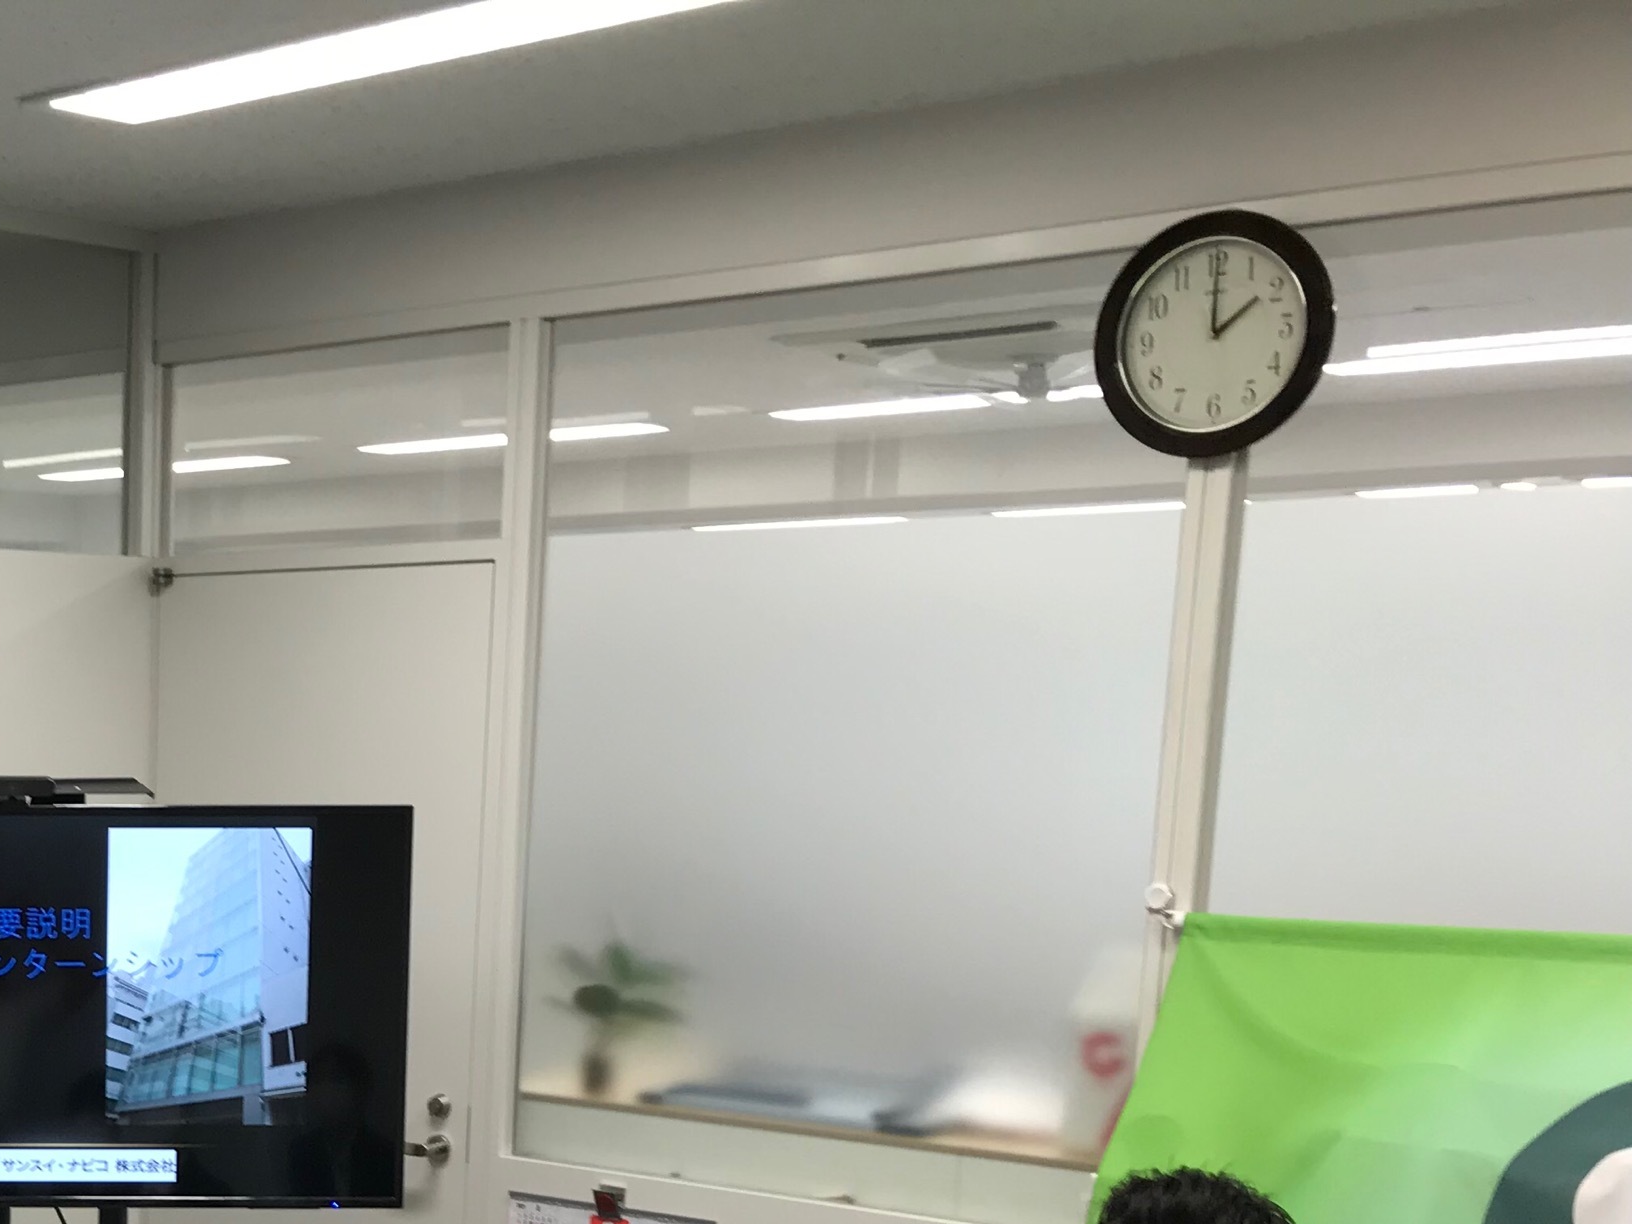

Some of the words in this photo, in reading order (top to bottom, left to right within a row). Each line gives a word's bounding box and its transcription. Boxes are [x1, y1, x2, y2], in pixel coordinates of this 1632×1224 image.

[1174, 266, 1189, 291] 11
[1248, 256, 1255, 281] 1
[1269, 277, 1284, 303] 2
[1148, 294, 1168, 320] 10
[1278, 313, 1293, 340] 3
[1140, 331, 1154, 357] 9
[1267, 351, 1280, 376] 4
[1149, 365, 1163, 390] 8
[1174, 388, 1186, 413] 7
[1241, 379, 1257, 405] 5
[1206, 393, 1221, 424] 6
[116, 1158, 177, 1174] 株式会社
